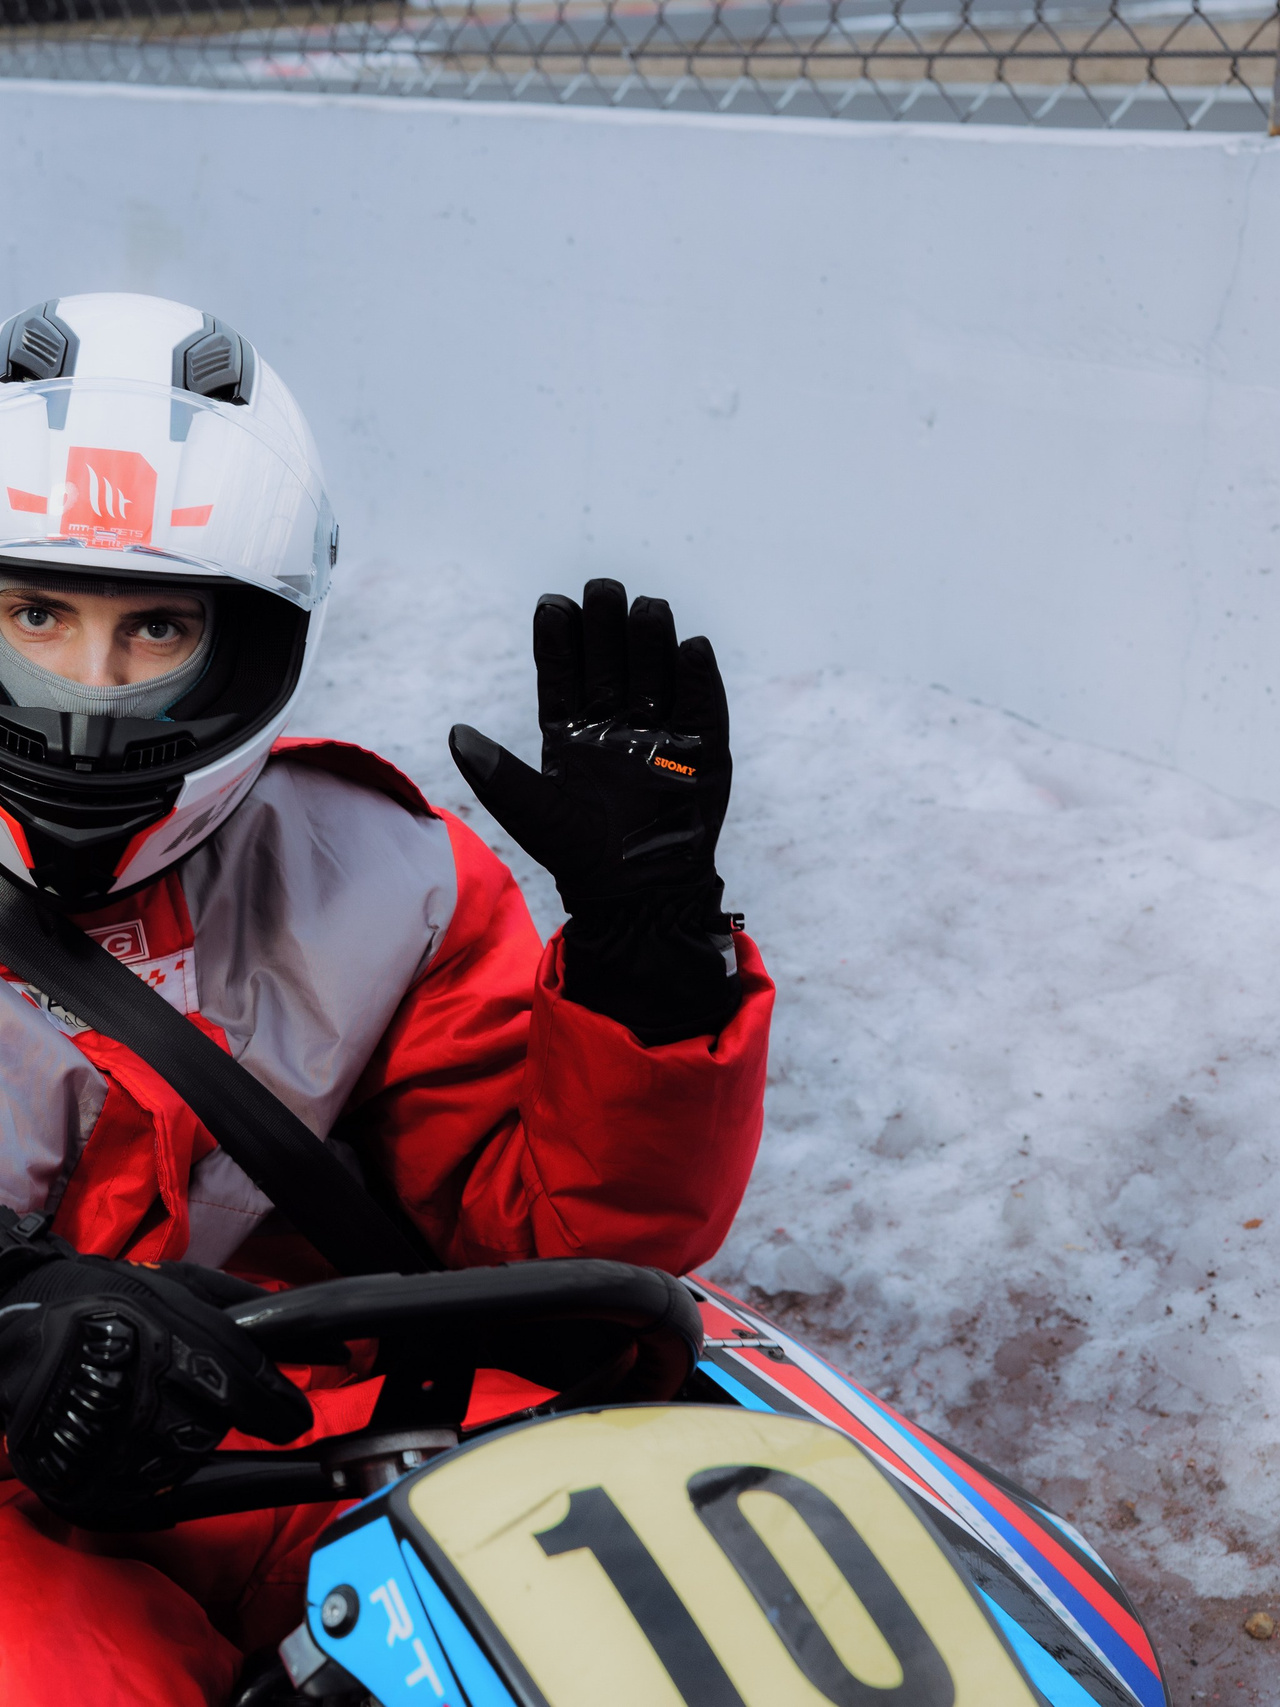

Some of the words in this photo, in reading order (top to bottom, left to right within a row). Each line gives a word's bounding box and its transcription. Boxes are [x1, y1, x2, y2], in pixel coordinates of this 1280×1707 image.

[653, 756, 697, 776] SUOMY
[369, 1577, 451, 1707] RT
[531, 1464, 956, 1707] 10
